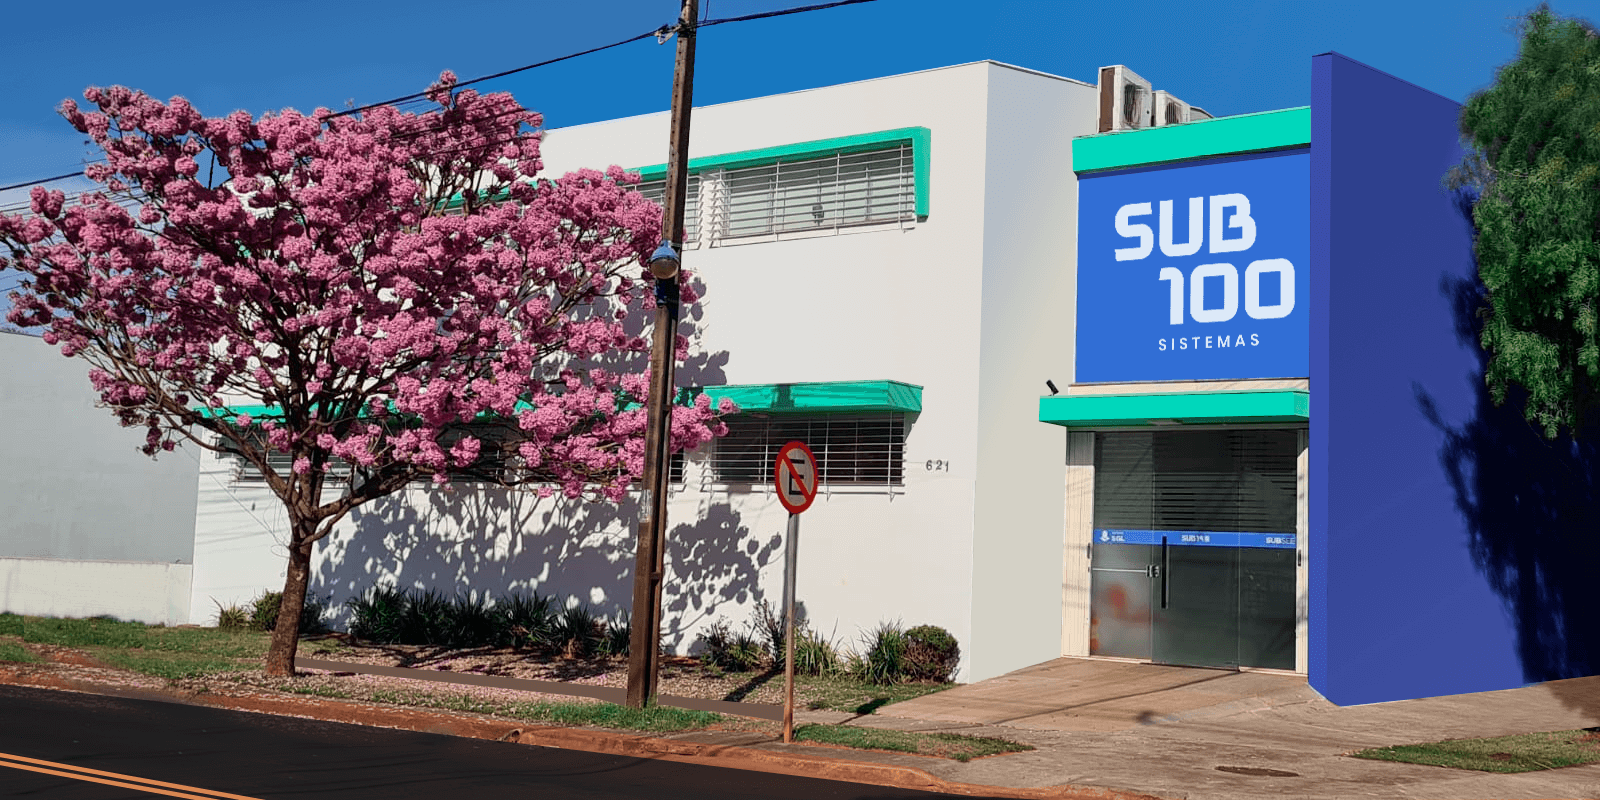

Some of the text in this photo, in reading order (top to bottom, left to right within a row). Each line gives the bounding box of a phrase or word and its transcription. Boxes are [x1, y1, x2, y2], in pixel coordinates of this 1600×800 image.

[1114, 193, 1257, 262] SUB
[1158, 258, 1296, 325] 100
[1158, 333, 1260, 351] SISTEMAS
[925, 460, 949, 473] 621
